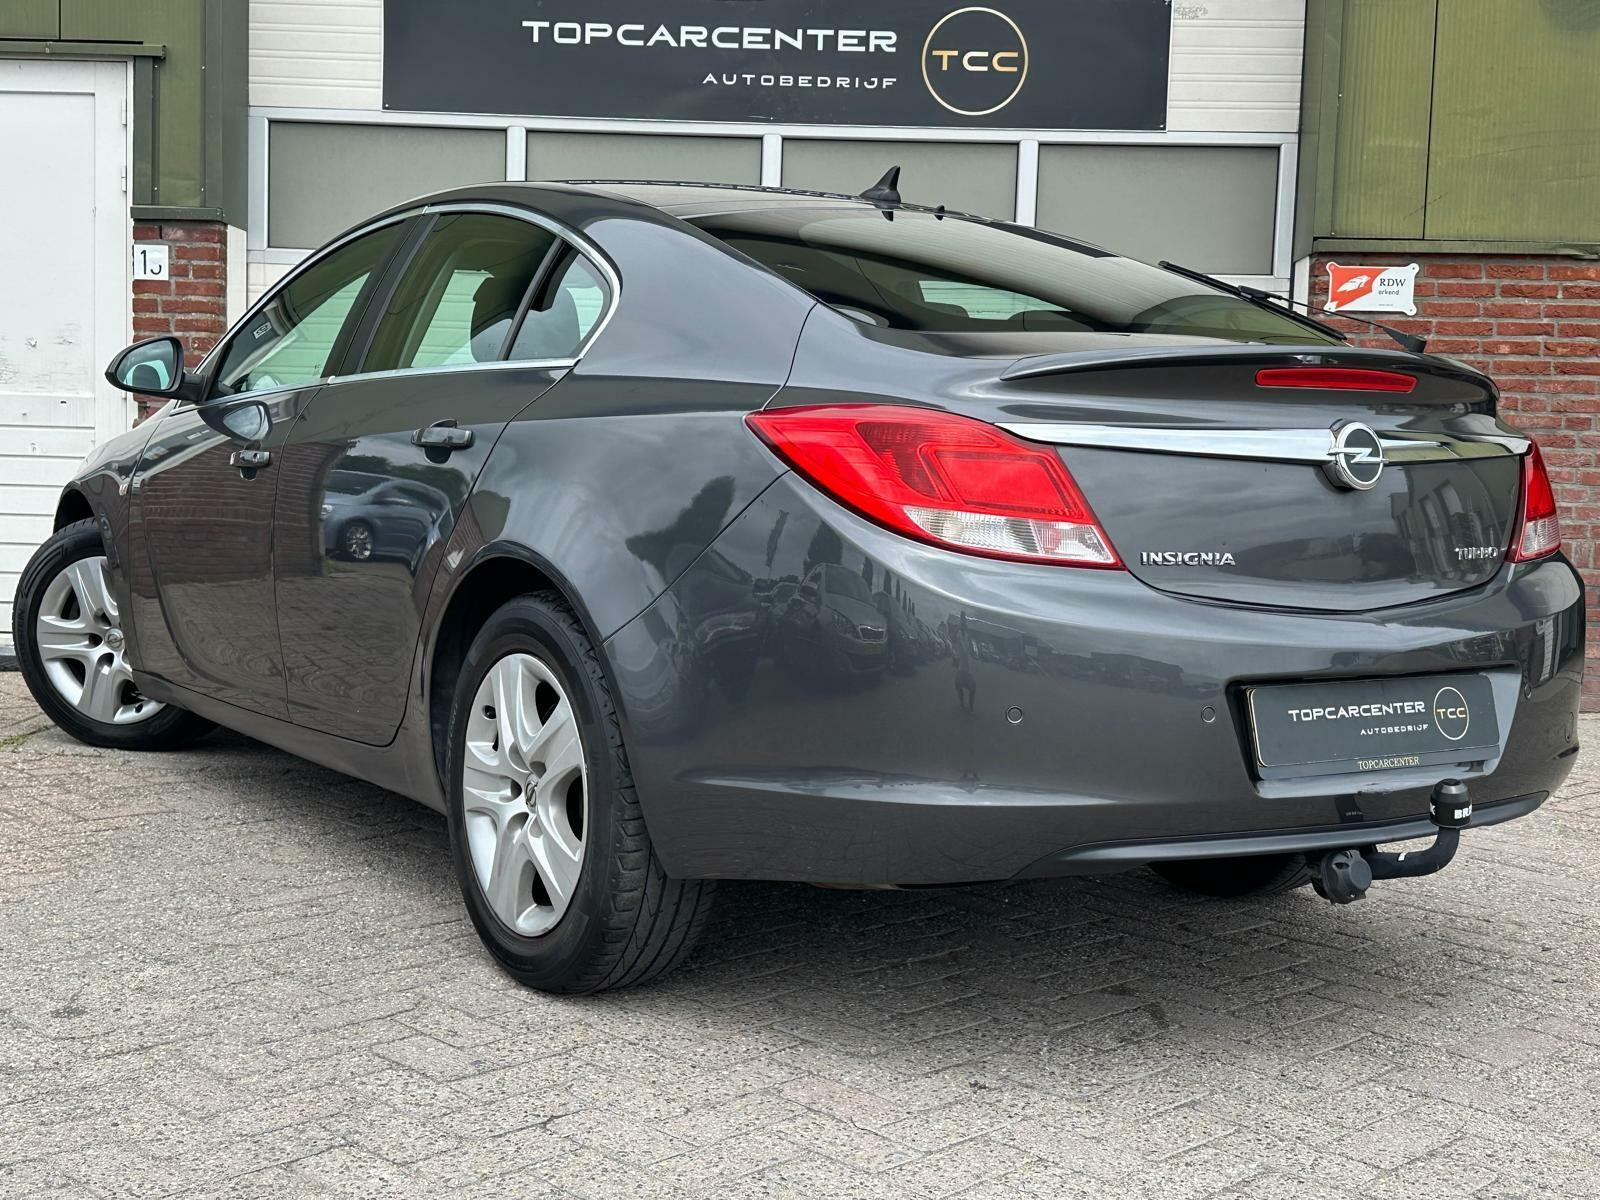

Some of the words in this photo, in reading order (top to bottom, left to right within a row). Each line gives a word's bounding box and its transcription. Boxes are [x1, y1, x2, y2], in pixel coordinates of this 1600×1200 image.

[521, 20, 898, 53] TOPCARCENTER
[931, 50, 1019, 72] TCC
[702, 72, 897, 90] AUTOBEDRIJF
[1379, 278, 1406, 287] RDW
[1140, 551, 1237, 566] INSIGNIA
[1454, 546, 1499, 561] TURBO
[1287, 701, 1426, 722] TOPCARCENTER
[1436, 707, 1467, 720] TCC
[1360, 723, 1429, 736] AUTOBEDRIJF
[1357, 756, 1420, 771] TOPCARCENTER
